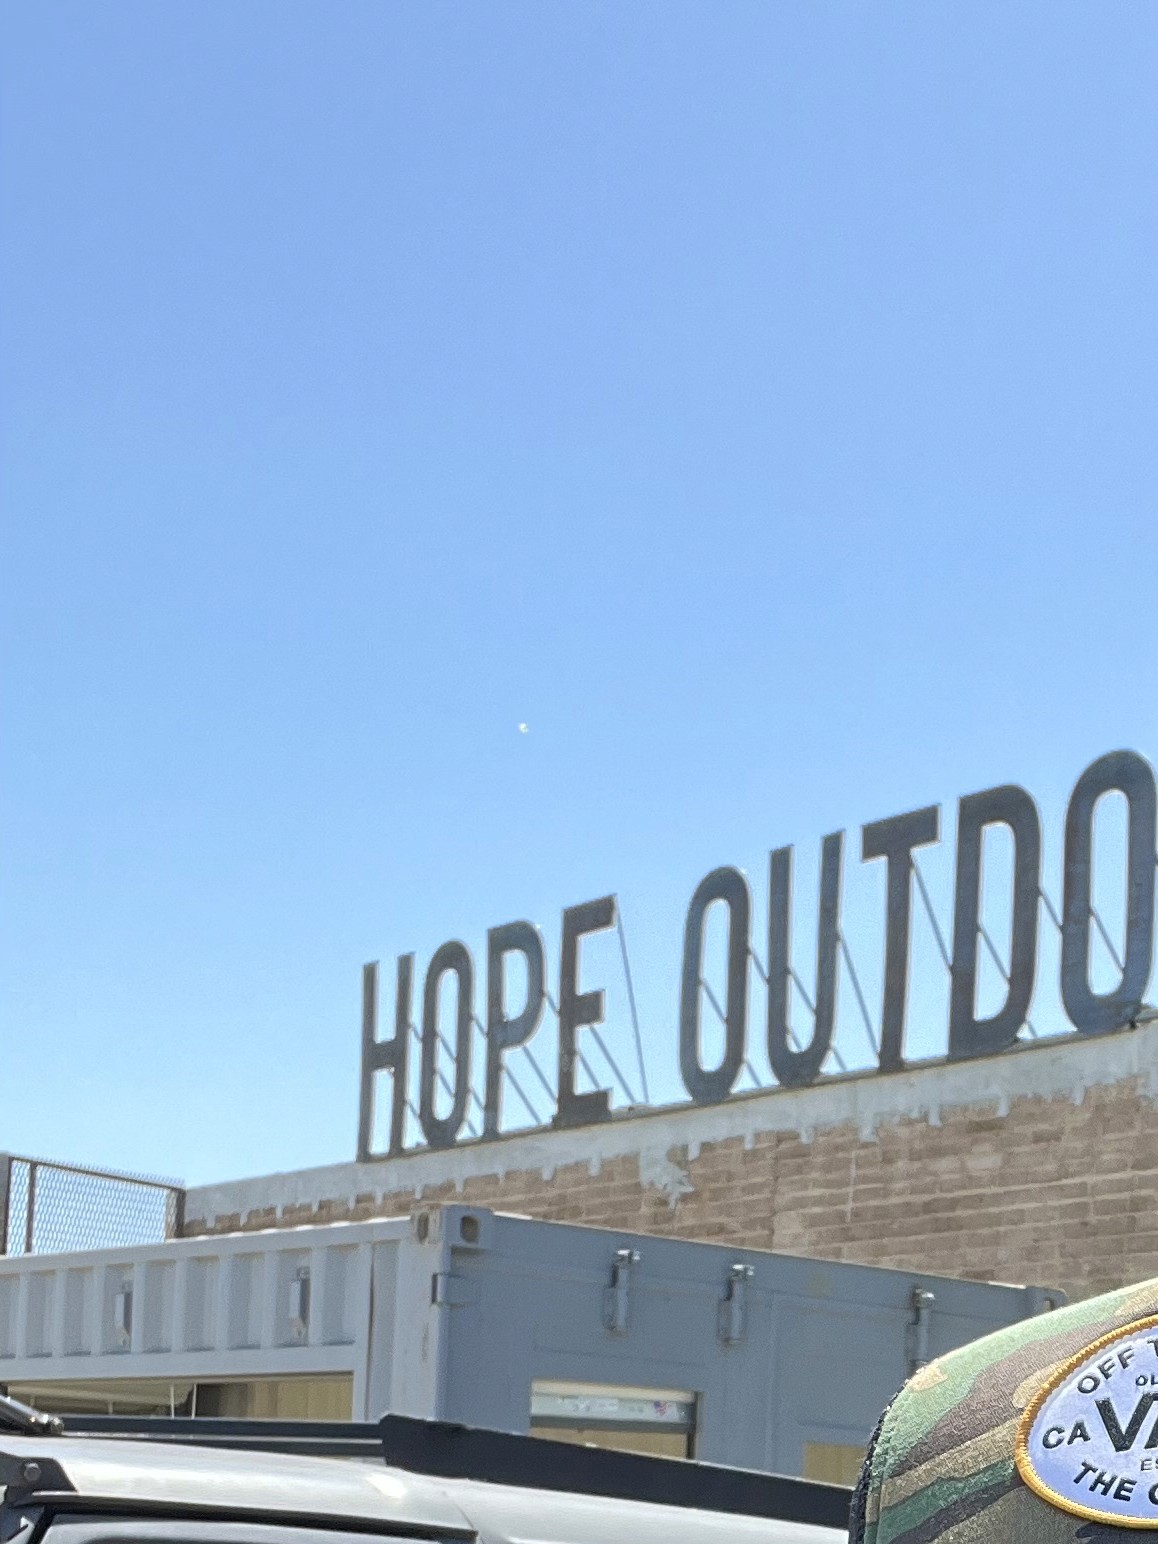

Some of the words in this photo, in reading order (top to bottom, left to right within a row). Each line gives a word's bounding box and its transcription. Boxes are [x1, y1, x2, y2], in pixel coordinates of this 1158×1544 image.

[356, 894, 617, 1163] HOPE
[1077, 1346, 1137, 1395] OFF
[1042, 1420, 1091, 1449] CA
[1073, 1462, 1136, 1501] THE
